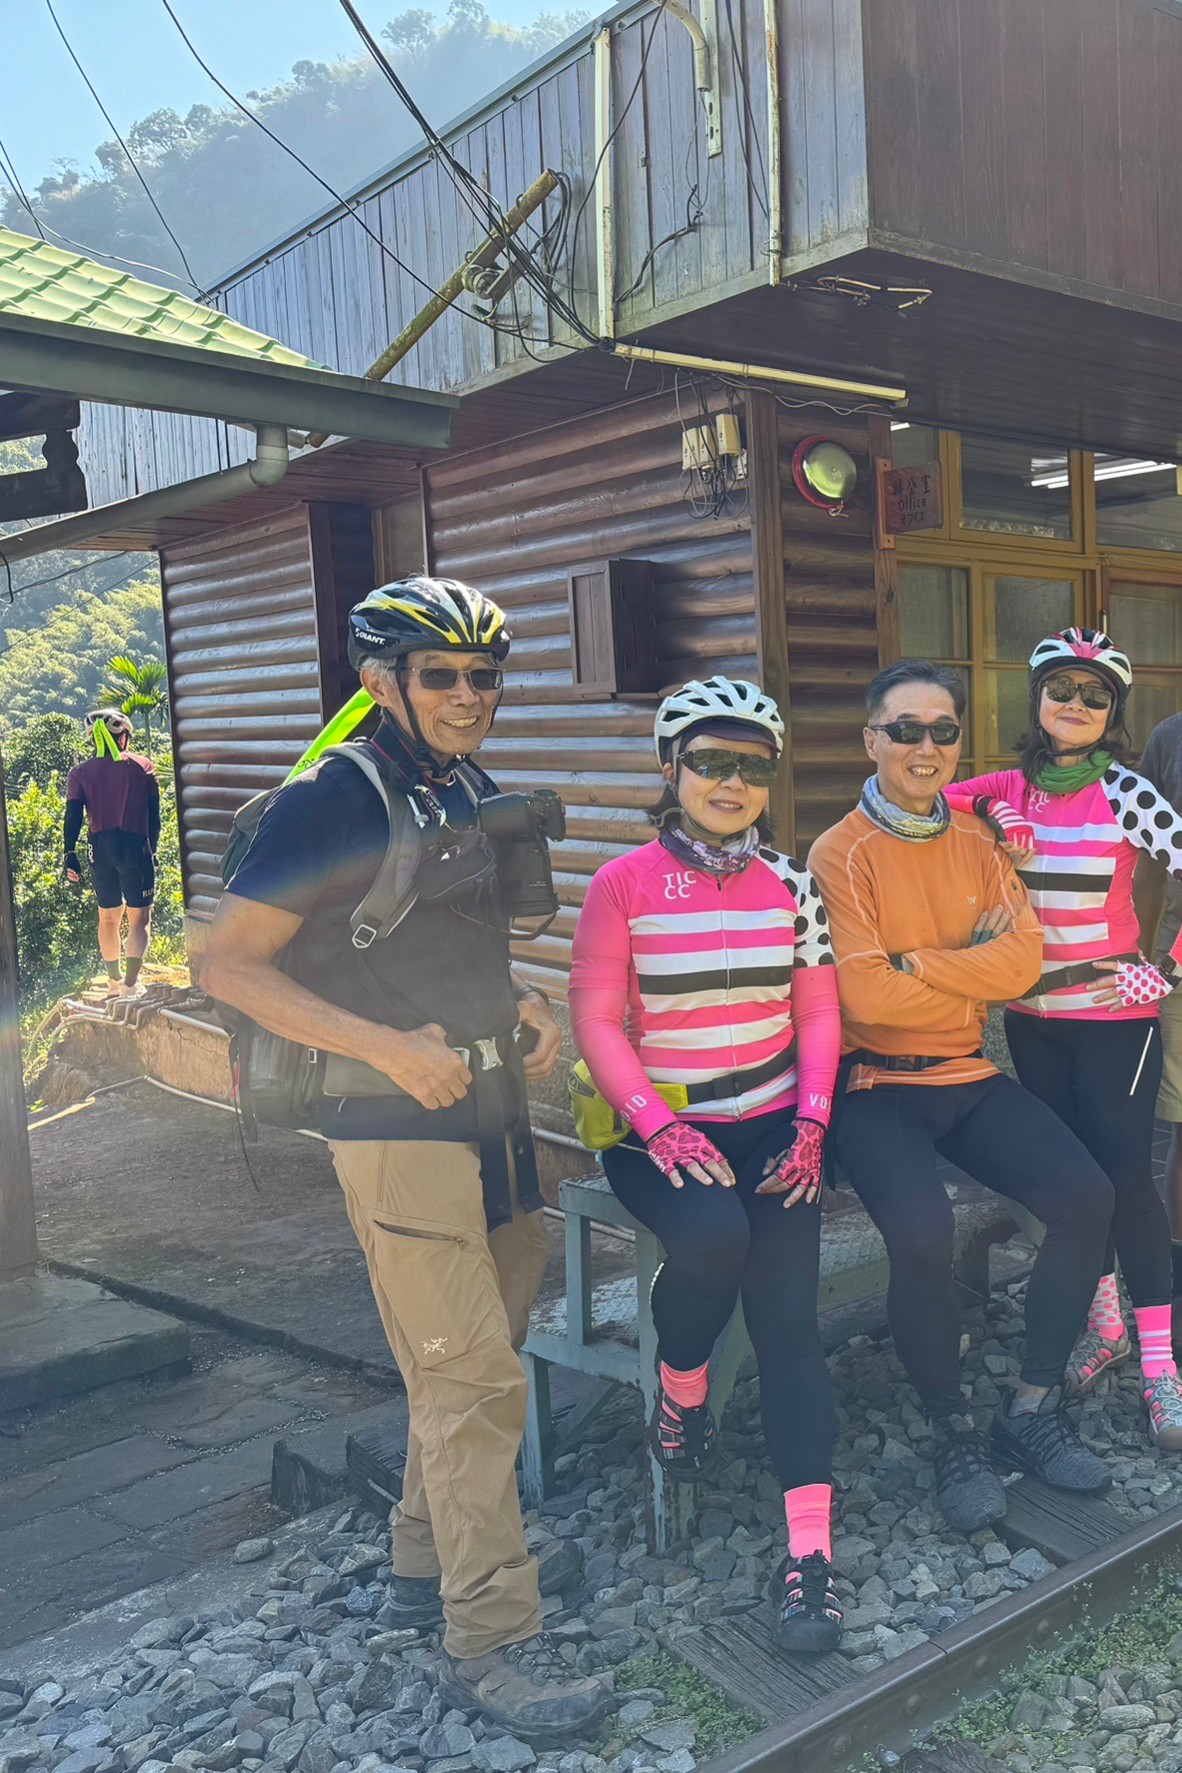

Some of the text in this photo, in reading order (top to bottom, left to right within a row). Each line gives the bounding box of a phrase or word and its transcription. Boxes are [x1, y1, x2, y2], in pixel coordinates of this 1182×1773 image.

[899, 497, 928, 511] Office
[360, 631, 386, 645] GIANT
[662, 870, 697, 886] TIC
[664, 884, 691, 900] CC
[621, 1094, 648, 1122] OID
[809, 1093, 831, 1110] VO
